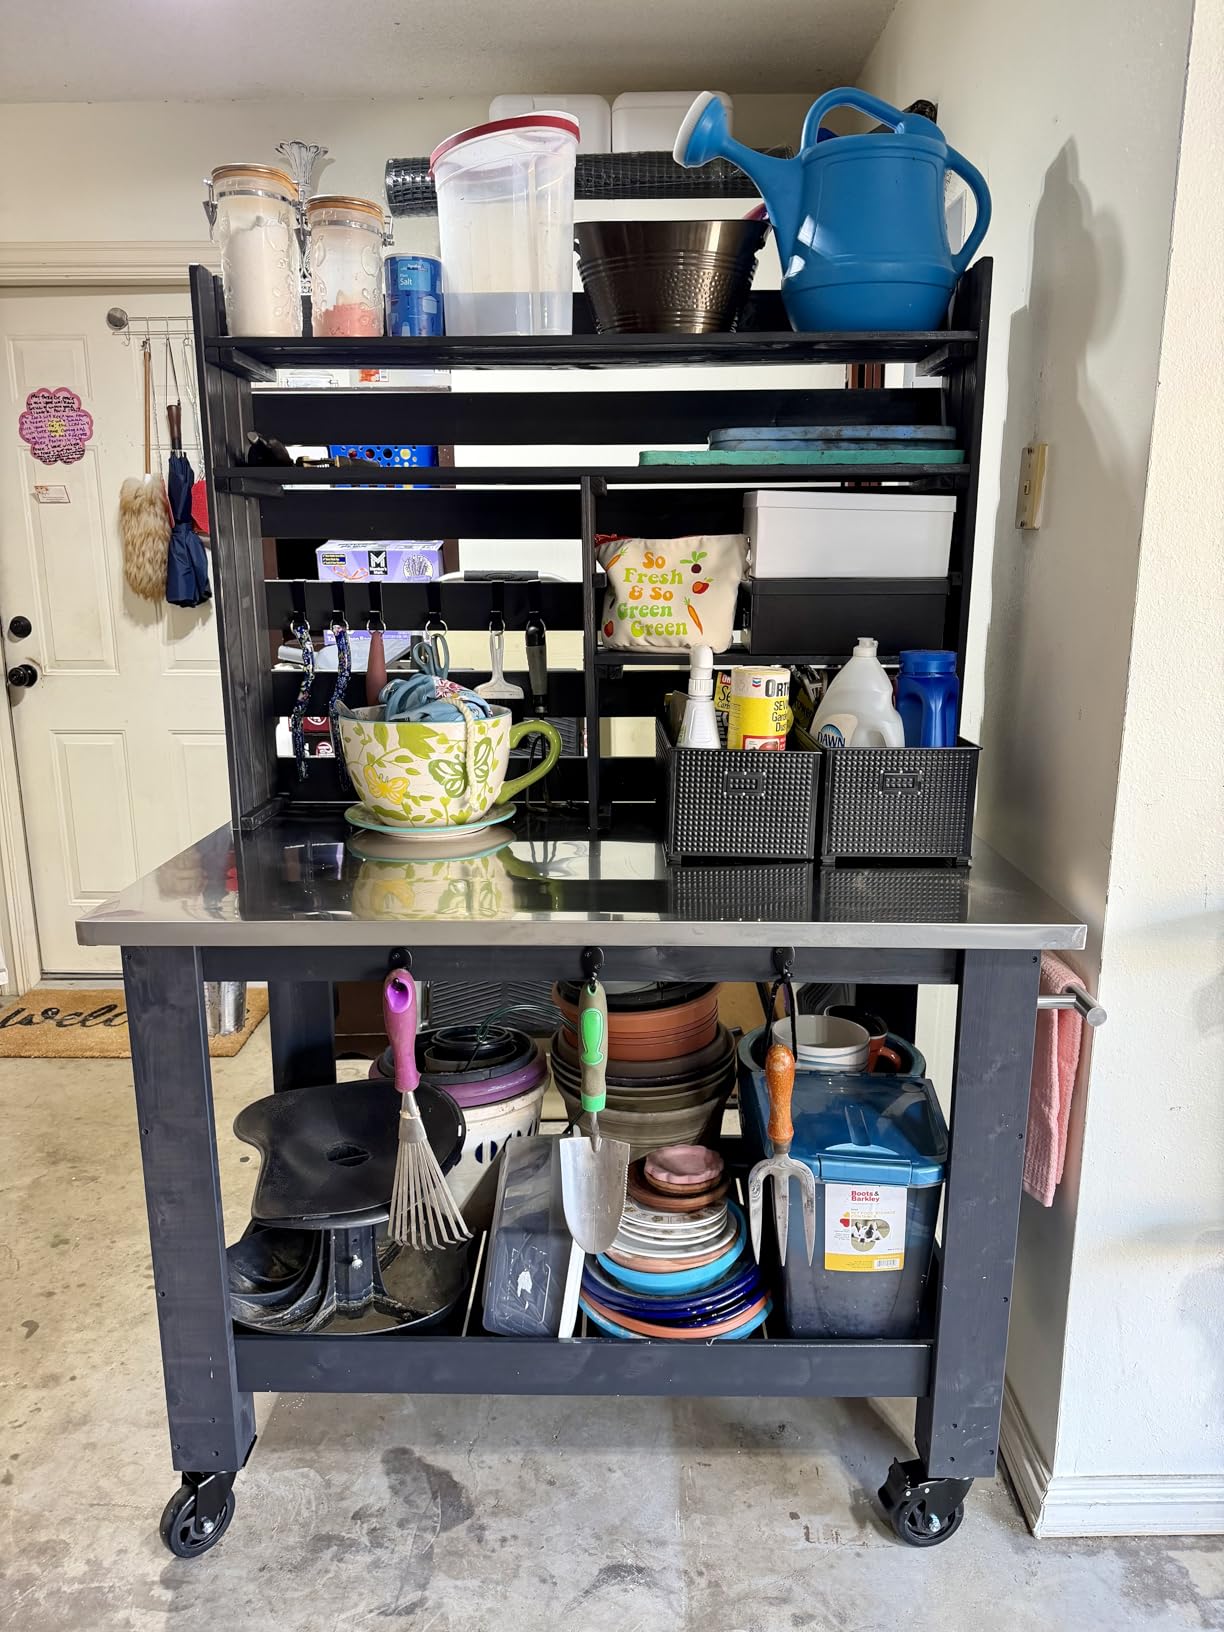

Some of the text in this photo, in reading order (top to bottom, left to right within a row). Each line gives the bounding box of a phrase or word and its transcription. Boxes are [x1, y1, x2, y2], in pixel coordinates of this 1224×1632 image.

[400, 278, 412, 286] Salt
[642, 551, 666, 569] So
[623, 567, 683, 585] Fresh
[629, 585, 674, 602] & So
[617, 602, 673, 620] Green
[630, 620, 688, 638] Green
[765, 679, 790, 698] ORT
[817, 732, 846, 749] DAWN
